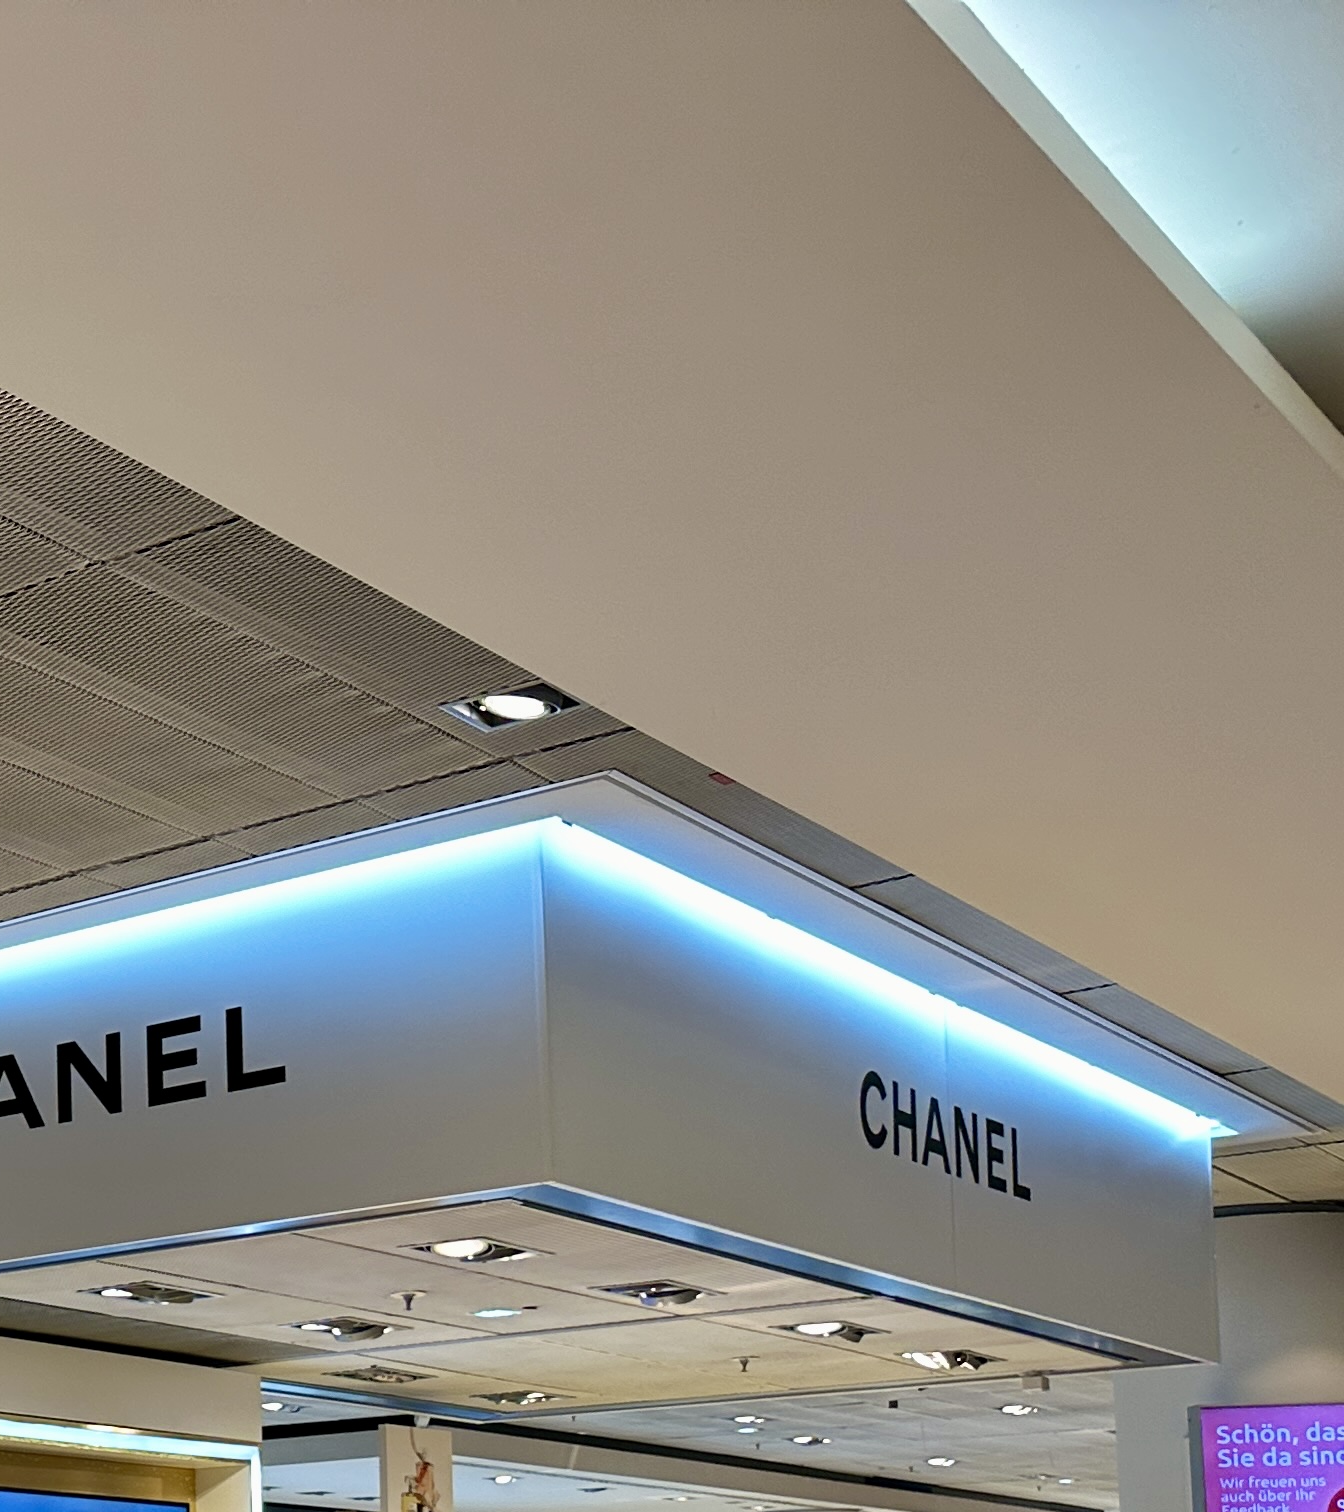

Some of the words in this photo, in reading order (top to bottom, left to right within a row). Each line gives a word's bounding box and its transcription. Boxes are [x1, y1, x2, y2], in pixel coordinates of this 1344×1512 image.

[860, 1070, 1031, 1202] CHANEL
[1216, 1423, 1299, 1446] Schön,
[1217, 1448, 1255, 1467] Sie
[1262, 1446, 1292, 1467] da
[1219, 1477, 1244, 1488] Wir
[1248, 1475, 1297, 1488] freuen
[1300, 1477, 1326, 1487] uns
[1221, 1490, 1255, 1502] auch
[1258, 1489, 1291, 1501] über
[1295, 1488, 1316, 1500] Ihr
